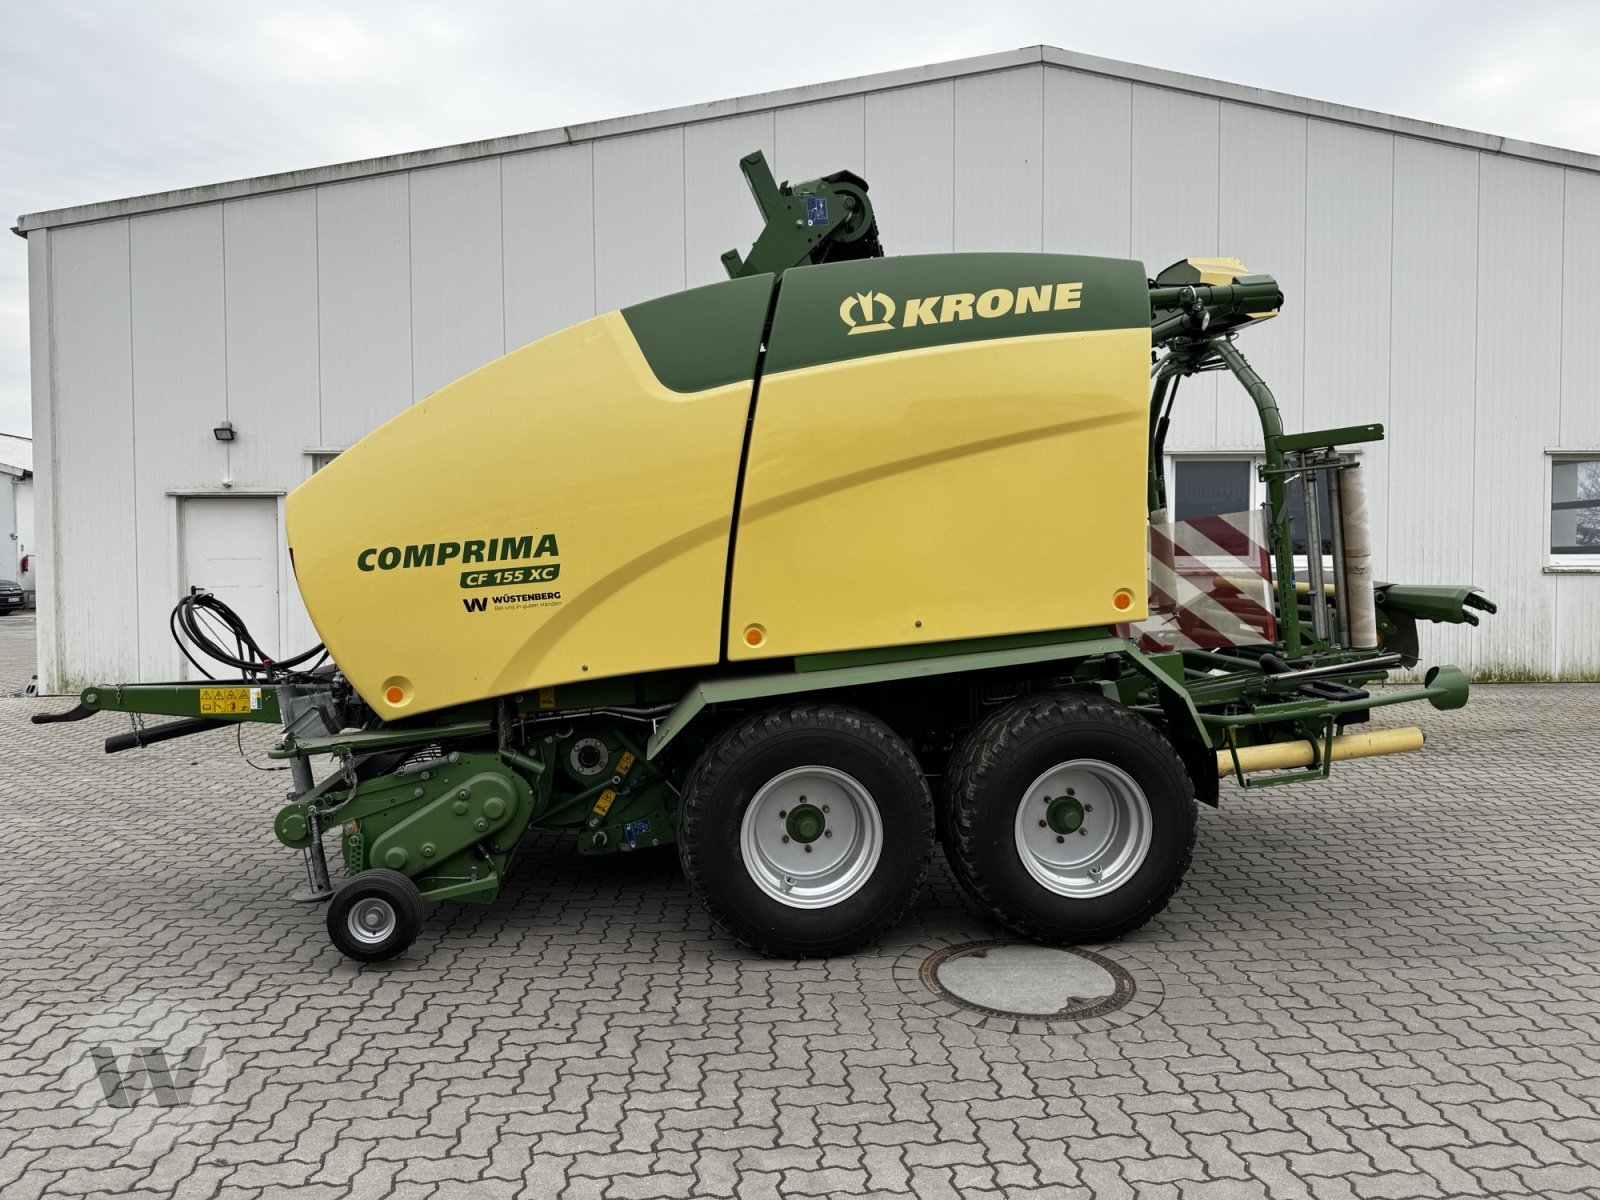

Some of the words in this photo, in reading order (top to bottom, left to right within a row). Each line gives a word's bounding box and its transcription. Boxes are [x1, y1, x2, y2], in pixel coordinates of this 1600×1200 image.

[902, 282, 1083, 328] KRONE
[357, 533, 560, 572] COMPRIMA
[466, 573, 488, 586] CF
[494, 570, 524, 584] 155
[529, 567, 555, 581] XC
[492, 591, 561, 604] WÜSTENBERG
[522, 602, 539, 610] guten
[540, 600, 563, 608] Händen
